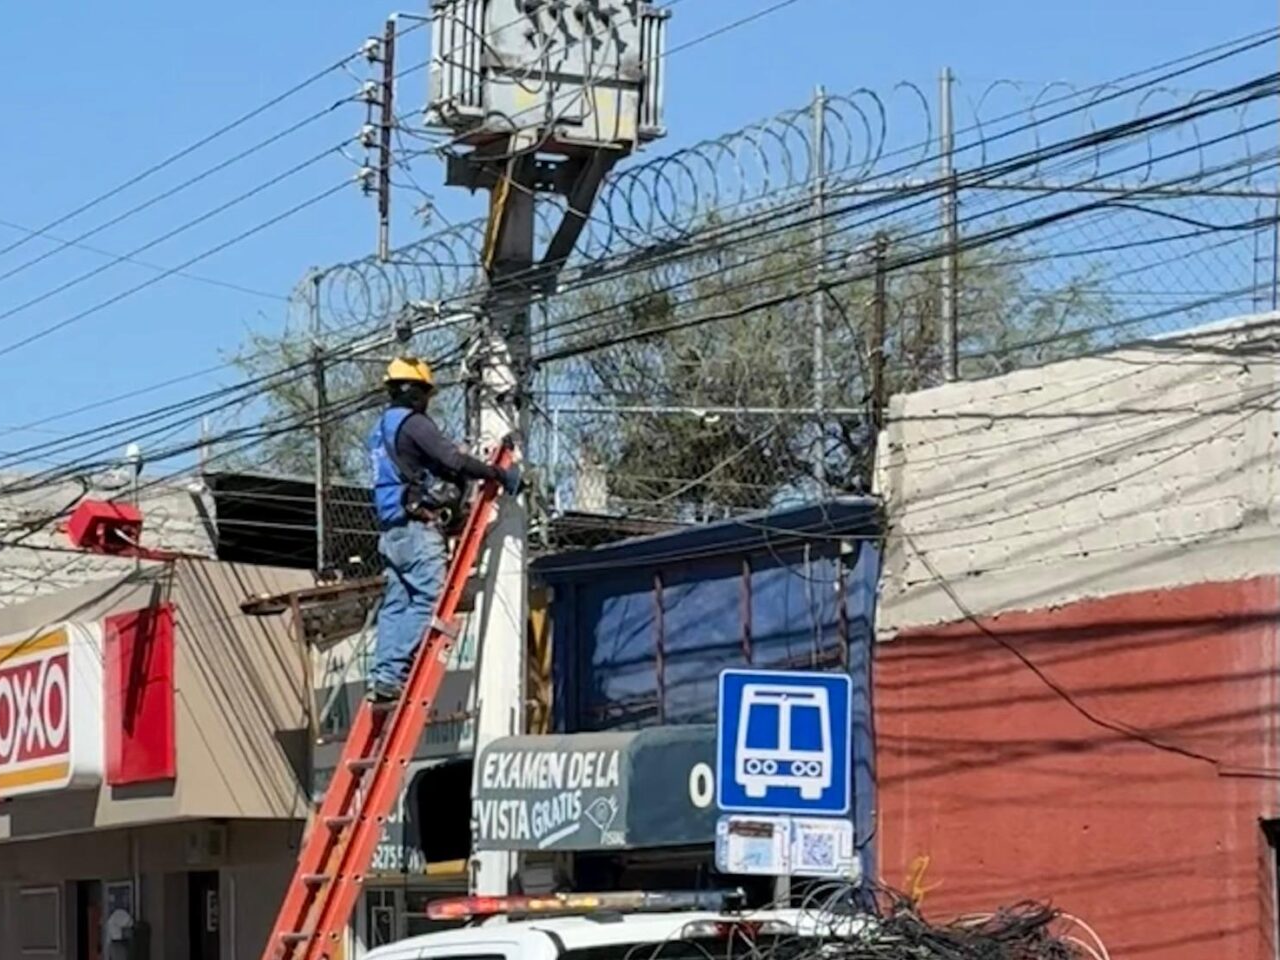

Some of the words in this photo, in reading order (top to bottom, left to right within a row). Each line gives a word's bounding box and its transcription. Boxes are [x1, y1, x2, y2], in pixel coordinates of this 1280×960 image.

[482, 752, 567, 789] EXAMEN
[476, 799, 530, 841] VISTA
[531, 790, 582, 837] GRATIS
